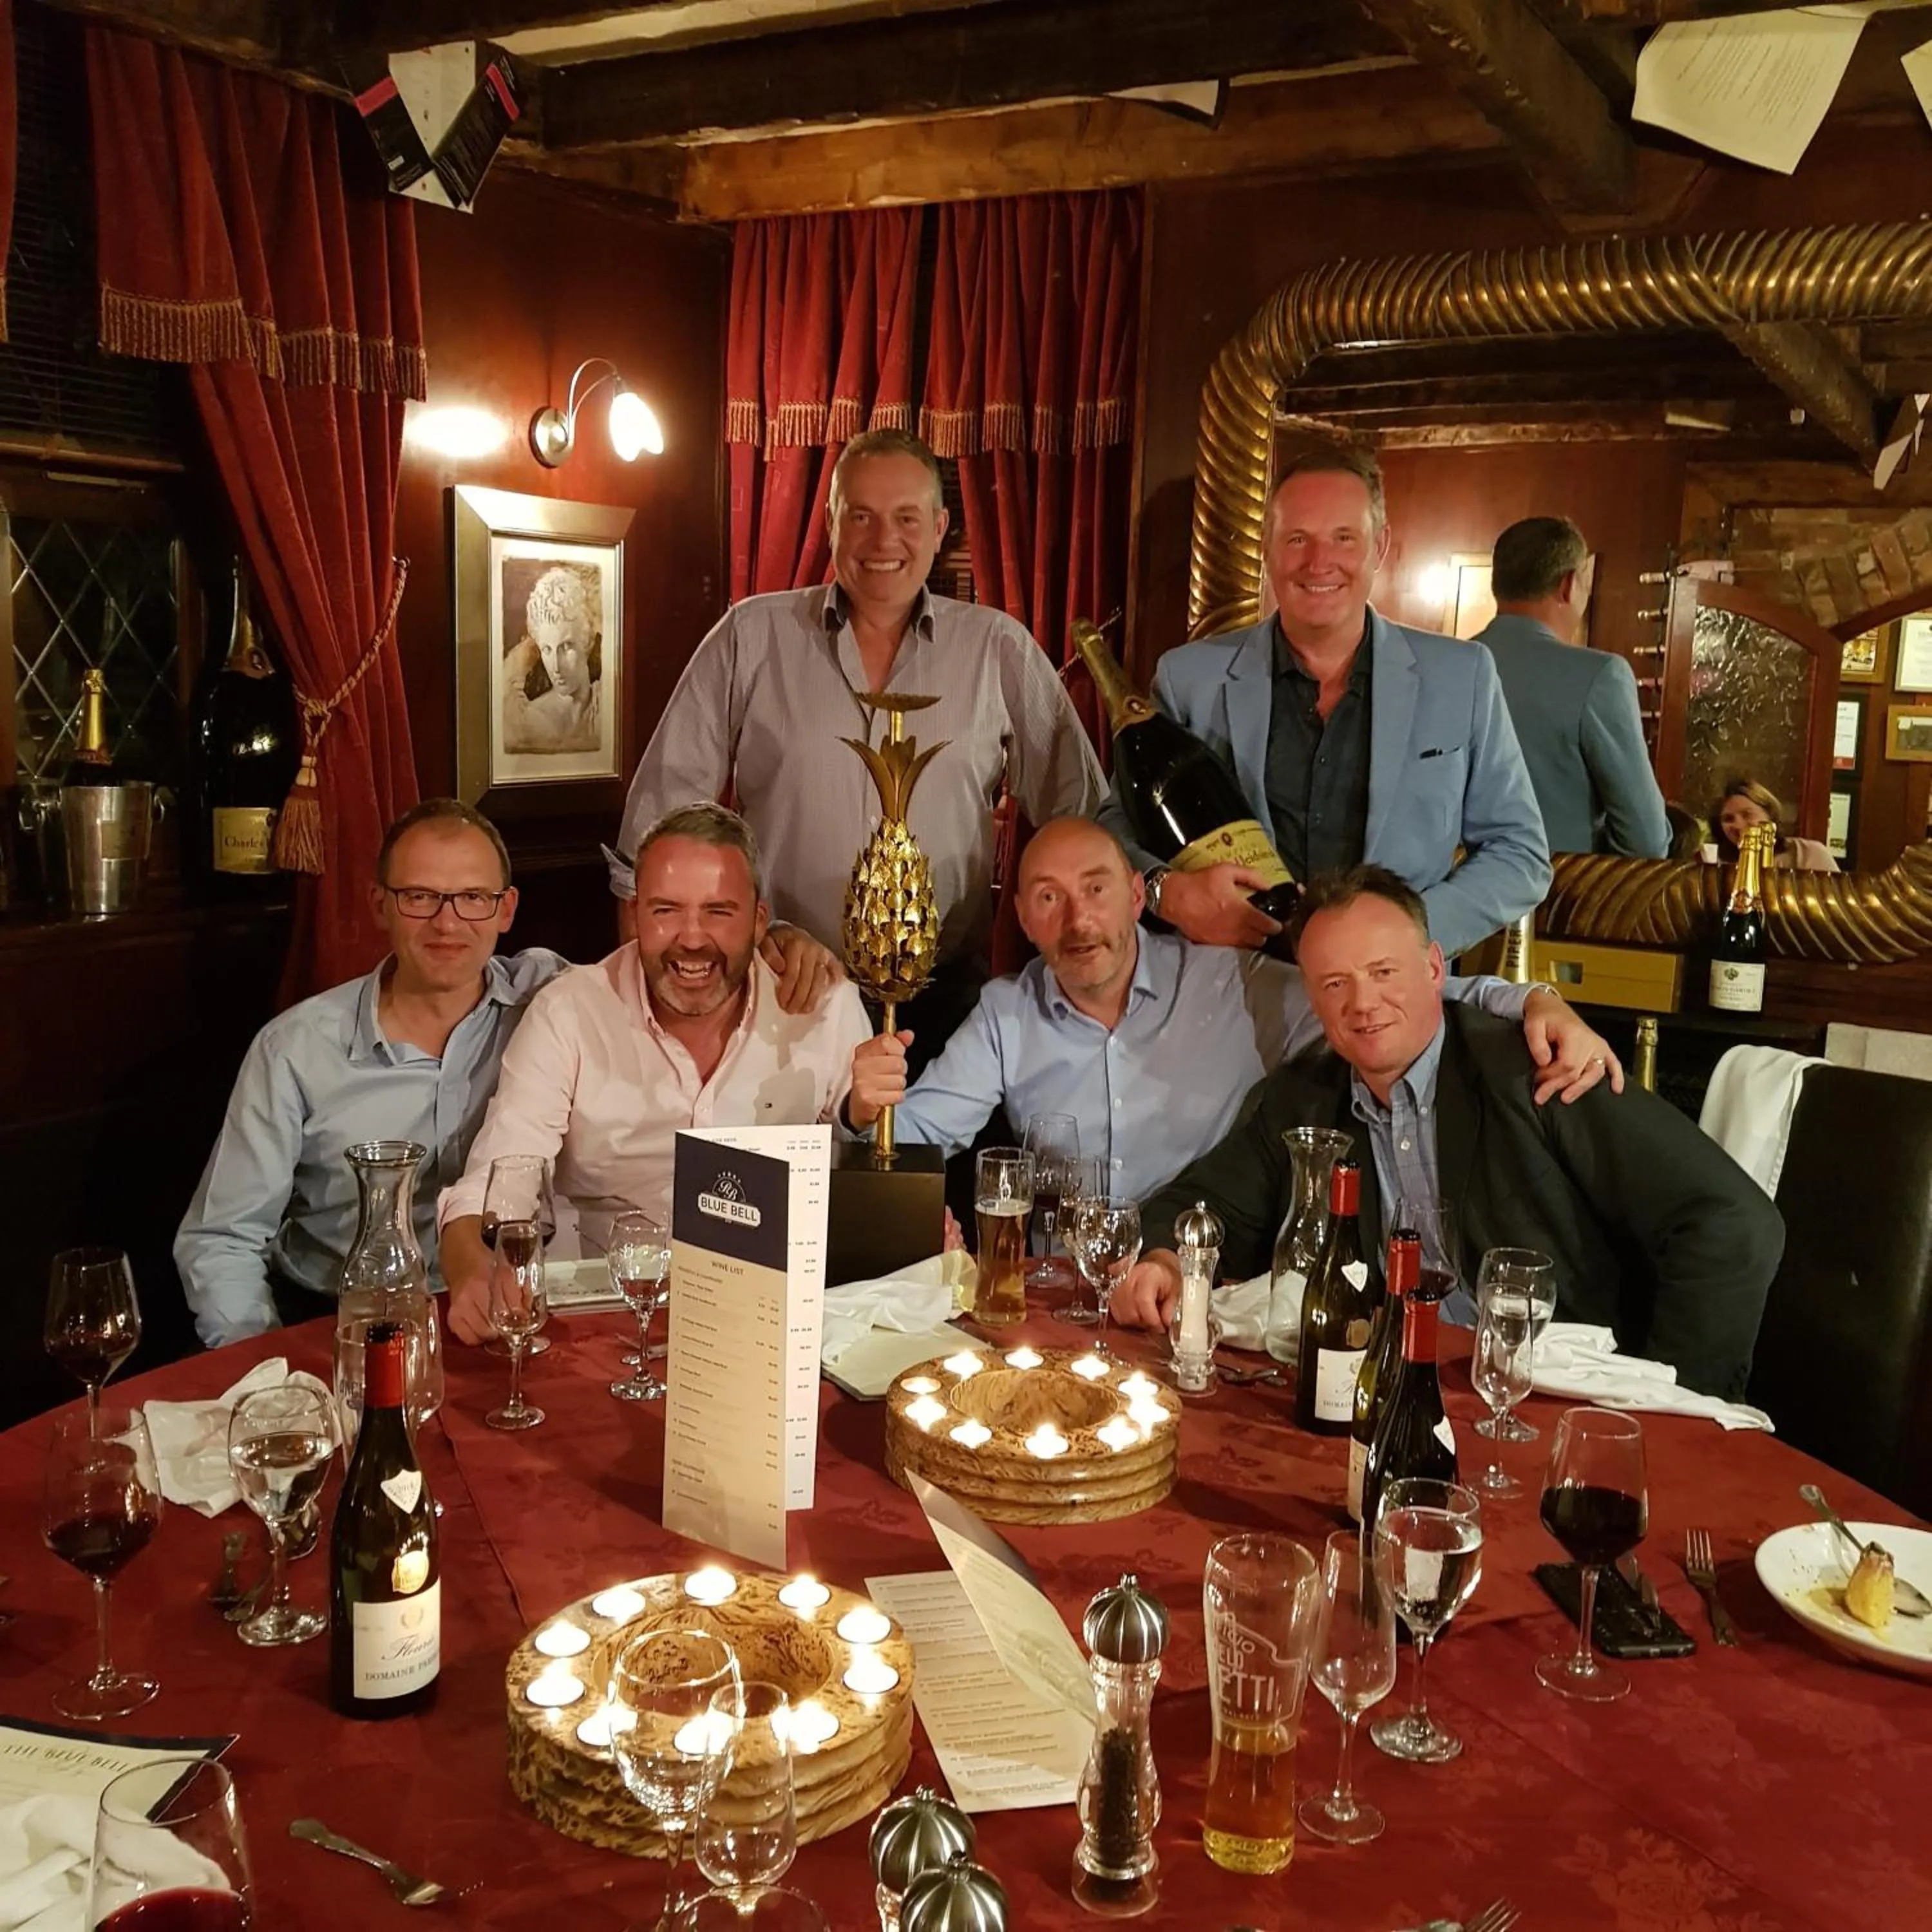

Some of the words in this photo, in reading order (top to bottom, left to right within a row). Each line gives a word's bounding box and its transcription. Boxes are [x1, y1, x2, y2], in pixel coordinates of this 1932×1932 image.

[701, 1196, 728, 1214] BLUE
[731, 1205, 757, 1222] BELL
[711, 1260, 728, 1272] WINE
[730, 1265, 743, 1275] LIST
[365, 1665, 415, 1680] DOMAINE
[43, 1748, 88, 1763] BLUE
[90, 1755, 128, 1773] BELL
